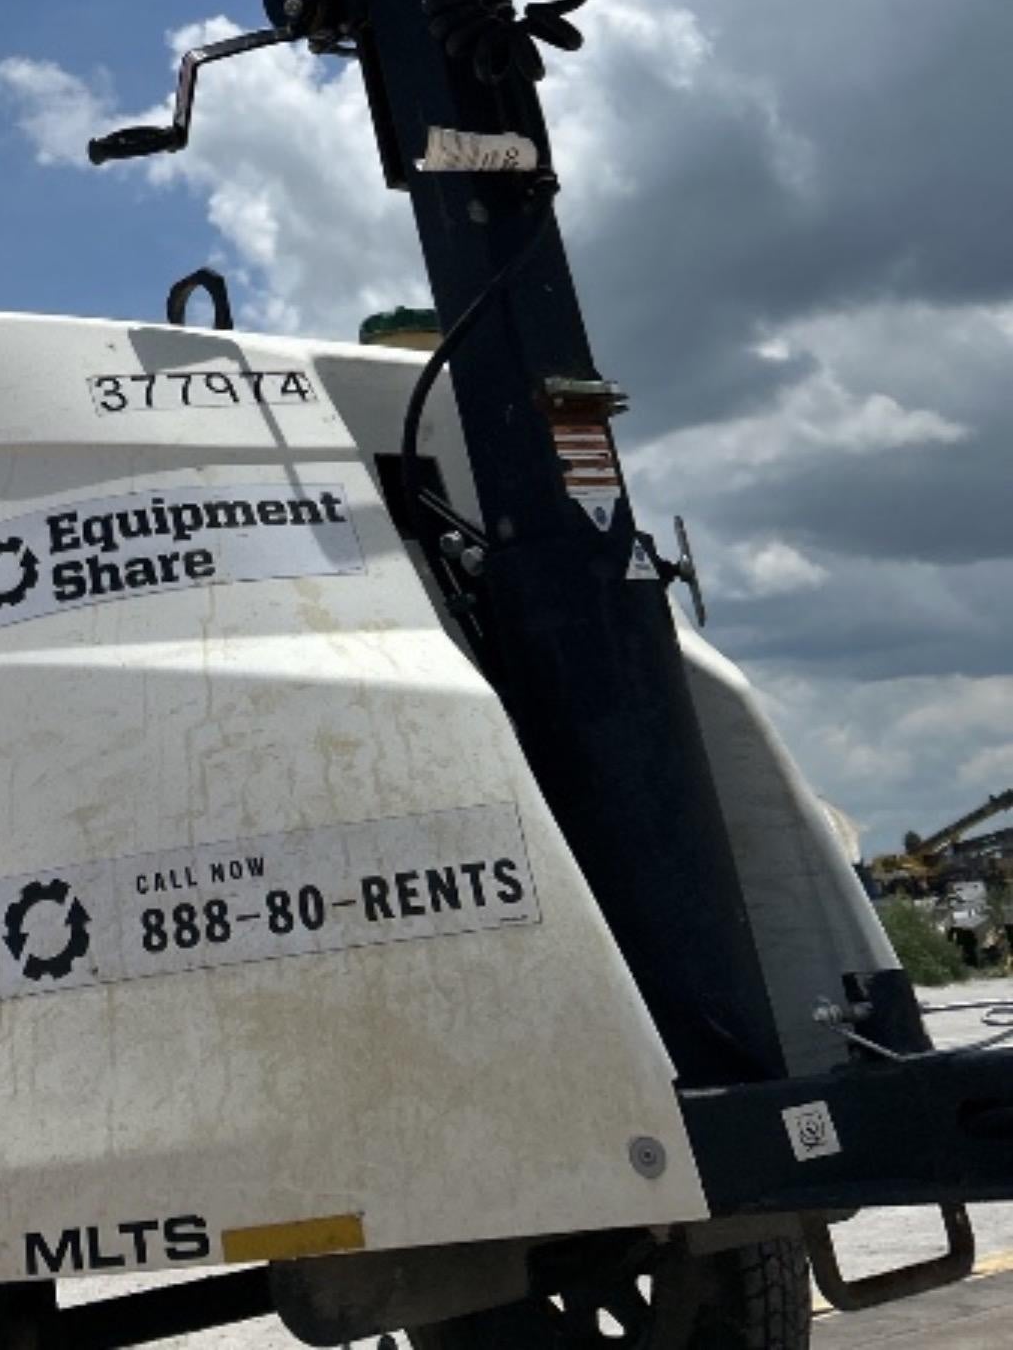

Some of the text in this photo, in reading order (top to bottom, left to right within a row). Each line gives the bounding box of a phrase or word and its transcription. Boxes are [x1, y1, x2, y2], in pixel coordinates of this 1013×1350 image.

[94, 370, 309, 412] 377974
[46, 491, 347, 553] Equipment
[51, 546, 217, 601] Share
[135, 857, 266, 895] CALL NOW
[140, 857, 525, 952] 888-80-RENTS
[25, 1214, 210, 1275] MLTS
